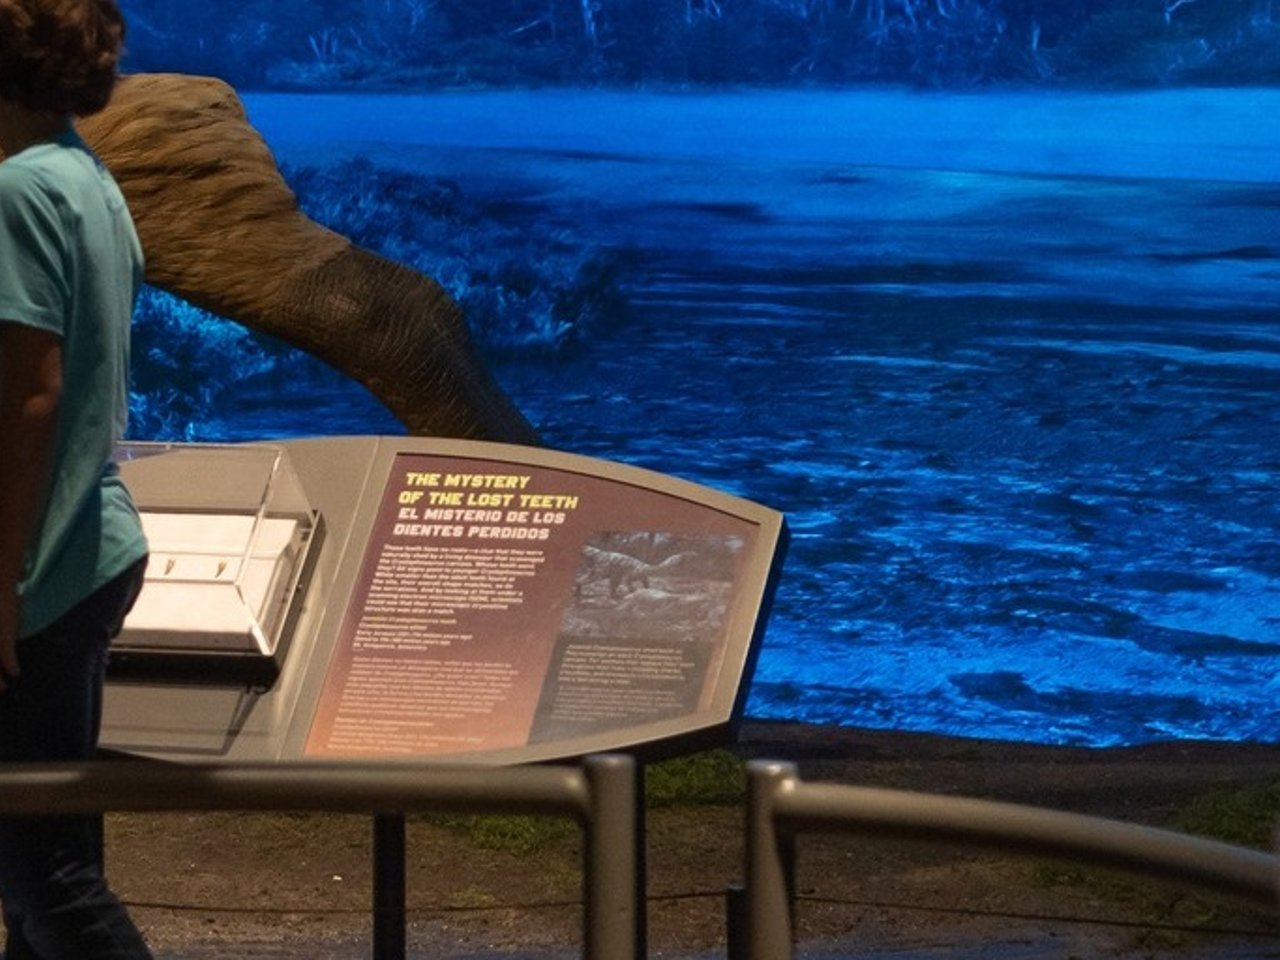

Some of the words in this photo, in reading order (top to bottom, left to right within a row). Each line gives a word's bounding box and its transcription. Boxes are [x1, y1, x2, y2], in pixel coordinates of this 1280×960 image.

[406, 473, 441, 486] THE
[444, 474, 530, 489] MYSTERY
[398, 491, 423, 504] OF
[429, 492, 463, 506] THE
[467, 493, 514, 507] LOST
[520, 494, 579, 508] TEETH
[398, 508, 418, 520] EL
[424, 508, 503, 522] MISTERIO
[506, 511, 529, 523] DE
[533, 512, 566, 524] LOS
[393, 524, 465, 537] DIENTES
[468, 526, 550, 540] PERDIDOS
